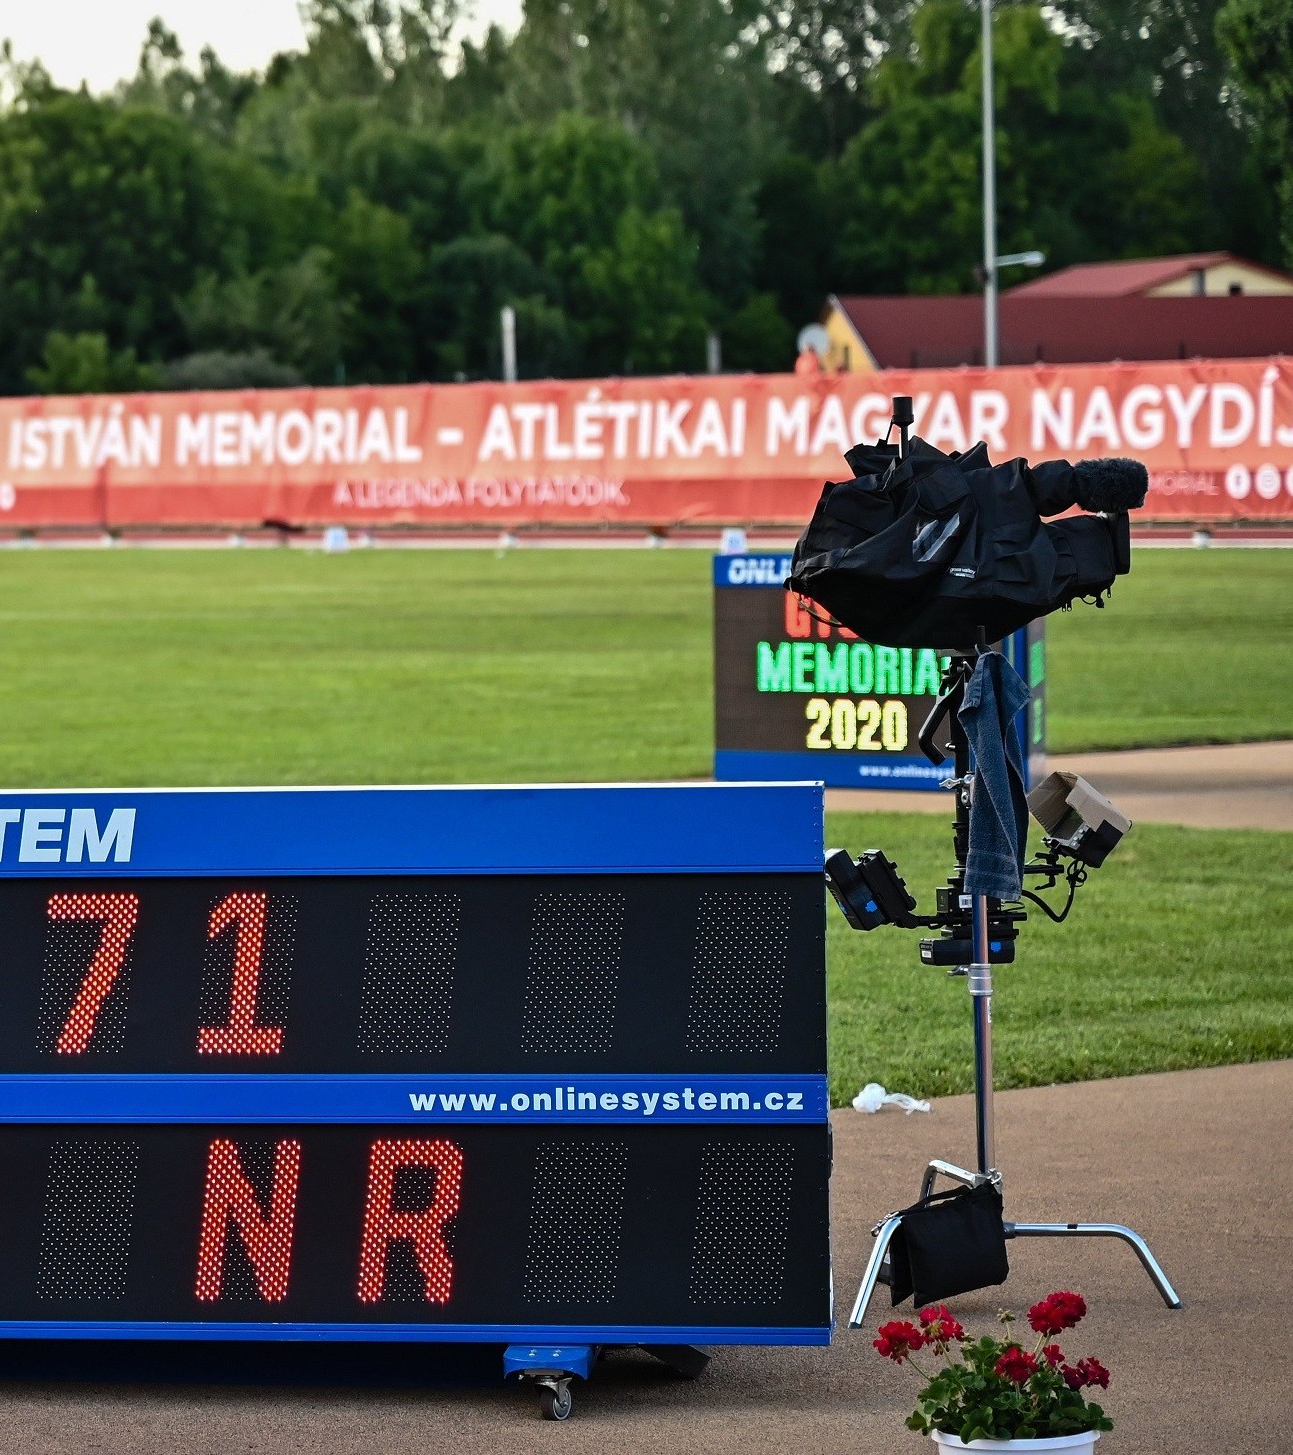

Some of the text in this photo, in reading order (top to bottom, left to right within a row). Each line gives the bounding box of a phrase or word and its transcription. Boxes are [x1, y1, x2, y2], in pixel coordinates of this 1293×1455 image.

[9, 402, 162, 470] ISTVÁN
[175, 407, 423, 467] MEMORIAL
[478, 387, 747, 460] ATLÉTIKAI
[806, 697, 908, 751] 2020
[410, 1087, 804, 1116] www.onlinesystem.cz
[194, 1137, 464, 1303] NR
